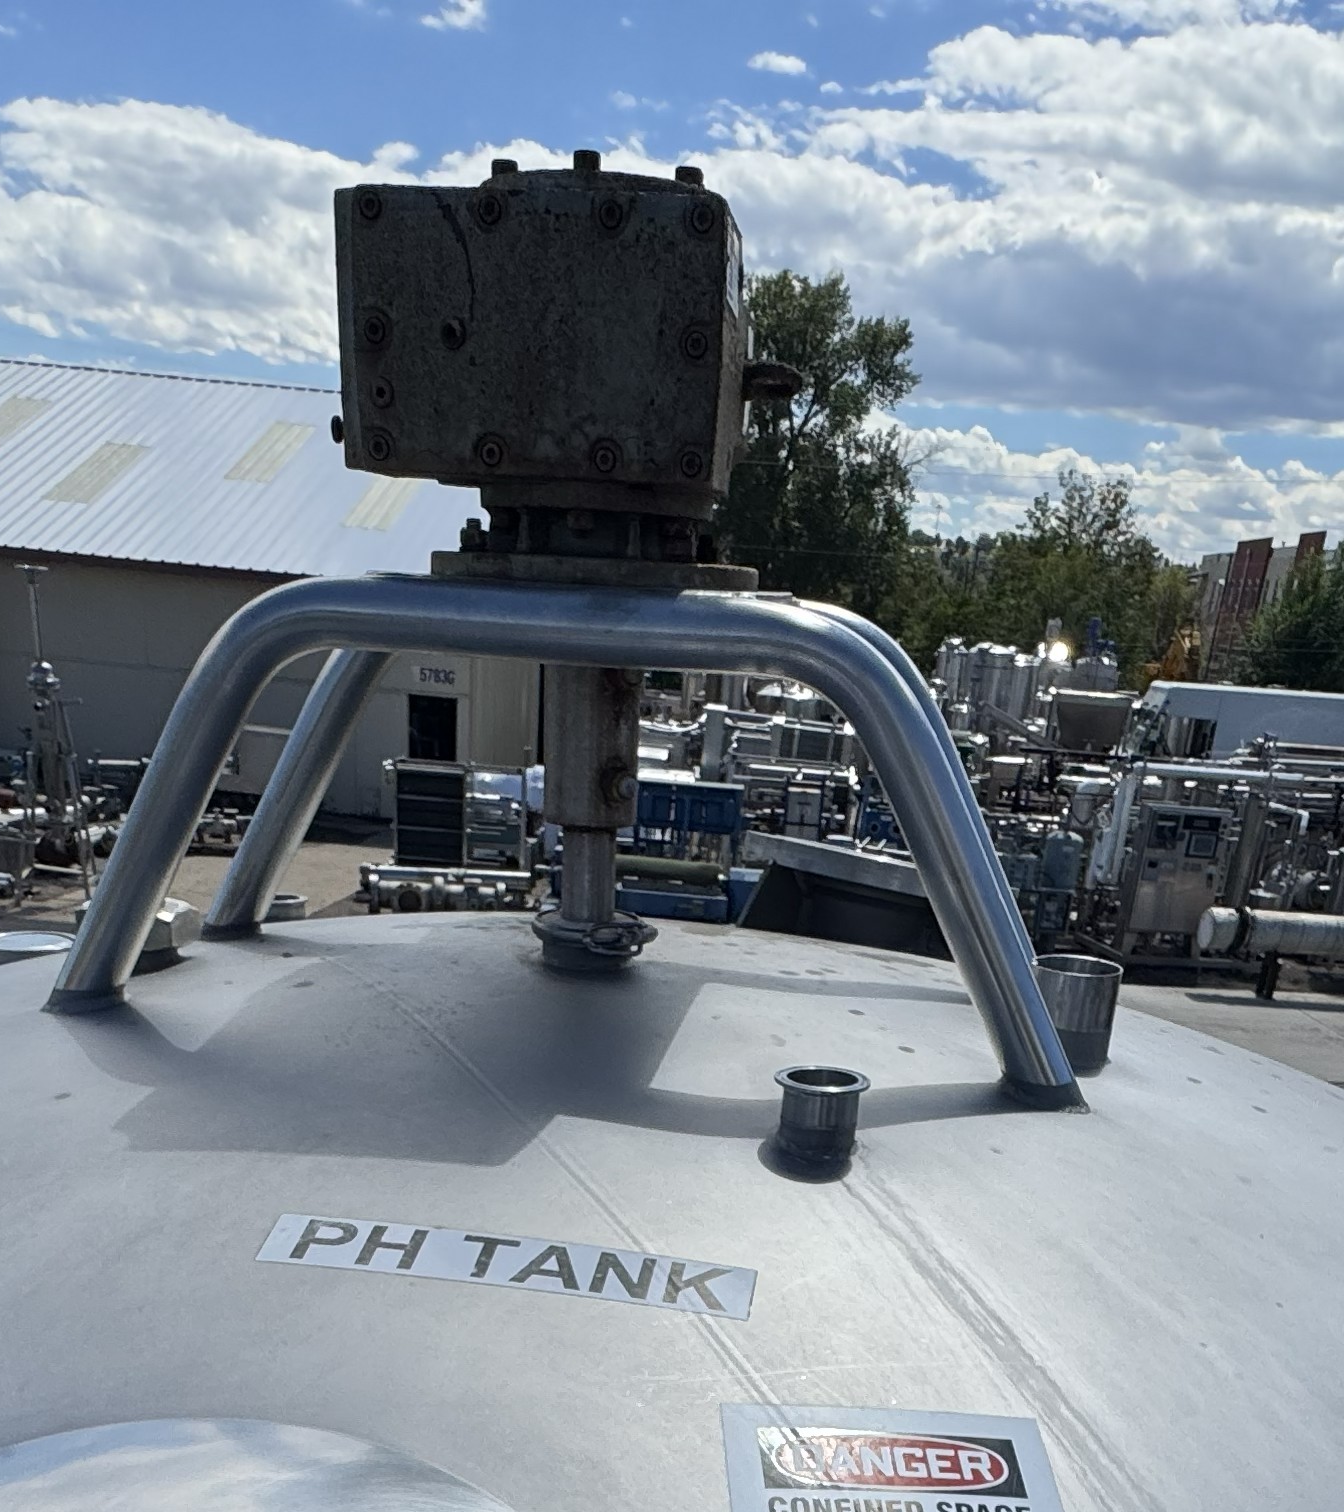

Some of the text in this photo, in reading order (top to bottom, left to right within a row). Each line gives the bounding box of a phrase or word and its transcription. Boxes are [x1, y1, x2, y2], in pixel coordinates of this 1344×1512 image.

[289, 1219, 733, 1313] PH TANK
[793, 1443, 996, 1482] DANGER
